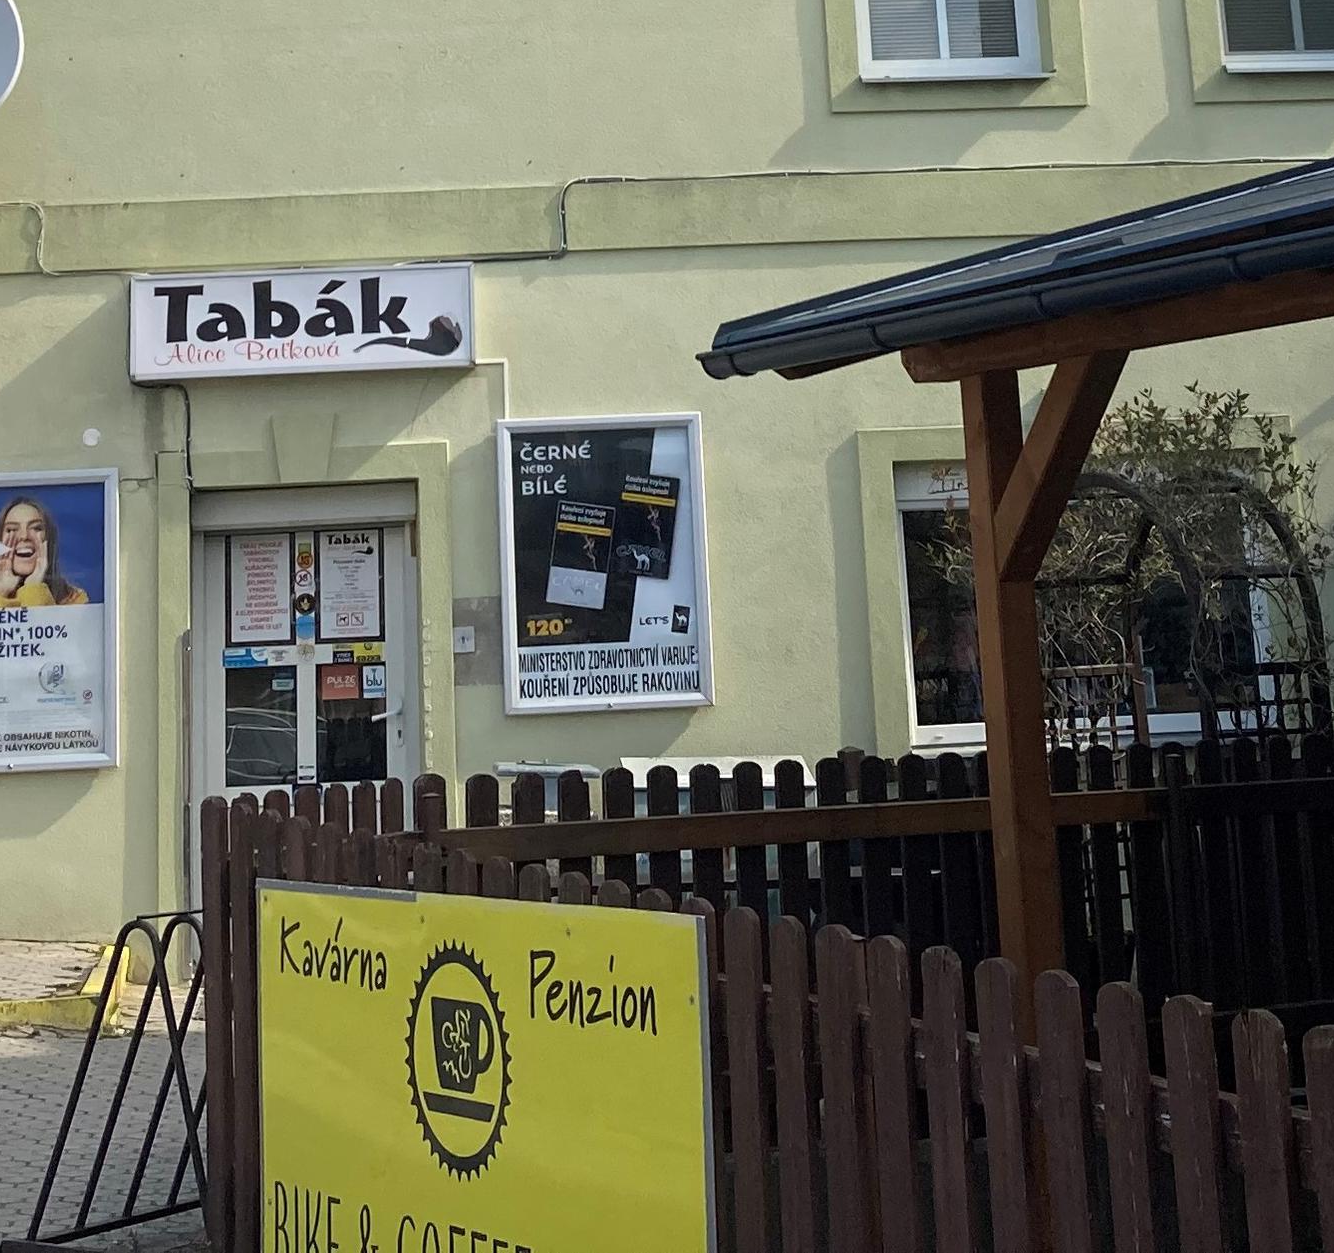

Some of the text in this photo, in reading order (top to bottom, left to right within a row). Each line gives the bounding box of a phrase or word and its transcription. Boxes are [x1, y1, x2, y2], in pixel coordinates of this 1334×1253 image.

[154, 276, 411, 344] Tabák
[154, 343, 226, 366] Alice
[520, 440, 592, 461] ČERNÉ
[520, 464, 554, 475] NEBO
[521, 474, 568, 495] BÍLÉ
[327, 533, 370, 545] Tabák
[27, 625, 68, 640] 100%
[526, 618, 564, 636] 120
[519, 650, 585, 673] MINISTERSTVO
[588, 644, 659, 670] ZDRAVOTNICTVÍ
[520, 669, 700, 699] KOUŘENÍ ZPŮSOBUJE RAKOVINU
[3, 731, 52, 742] OBSAHUJE
[280, 916, 388, 992] Kavárna
